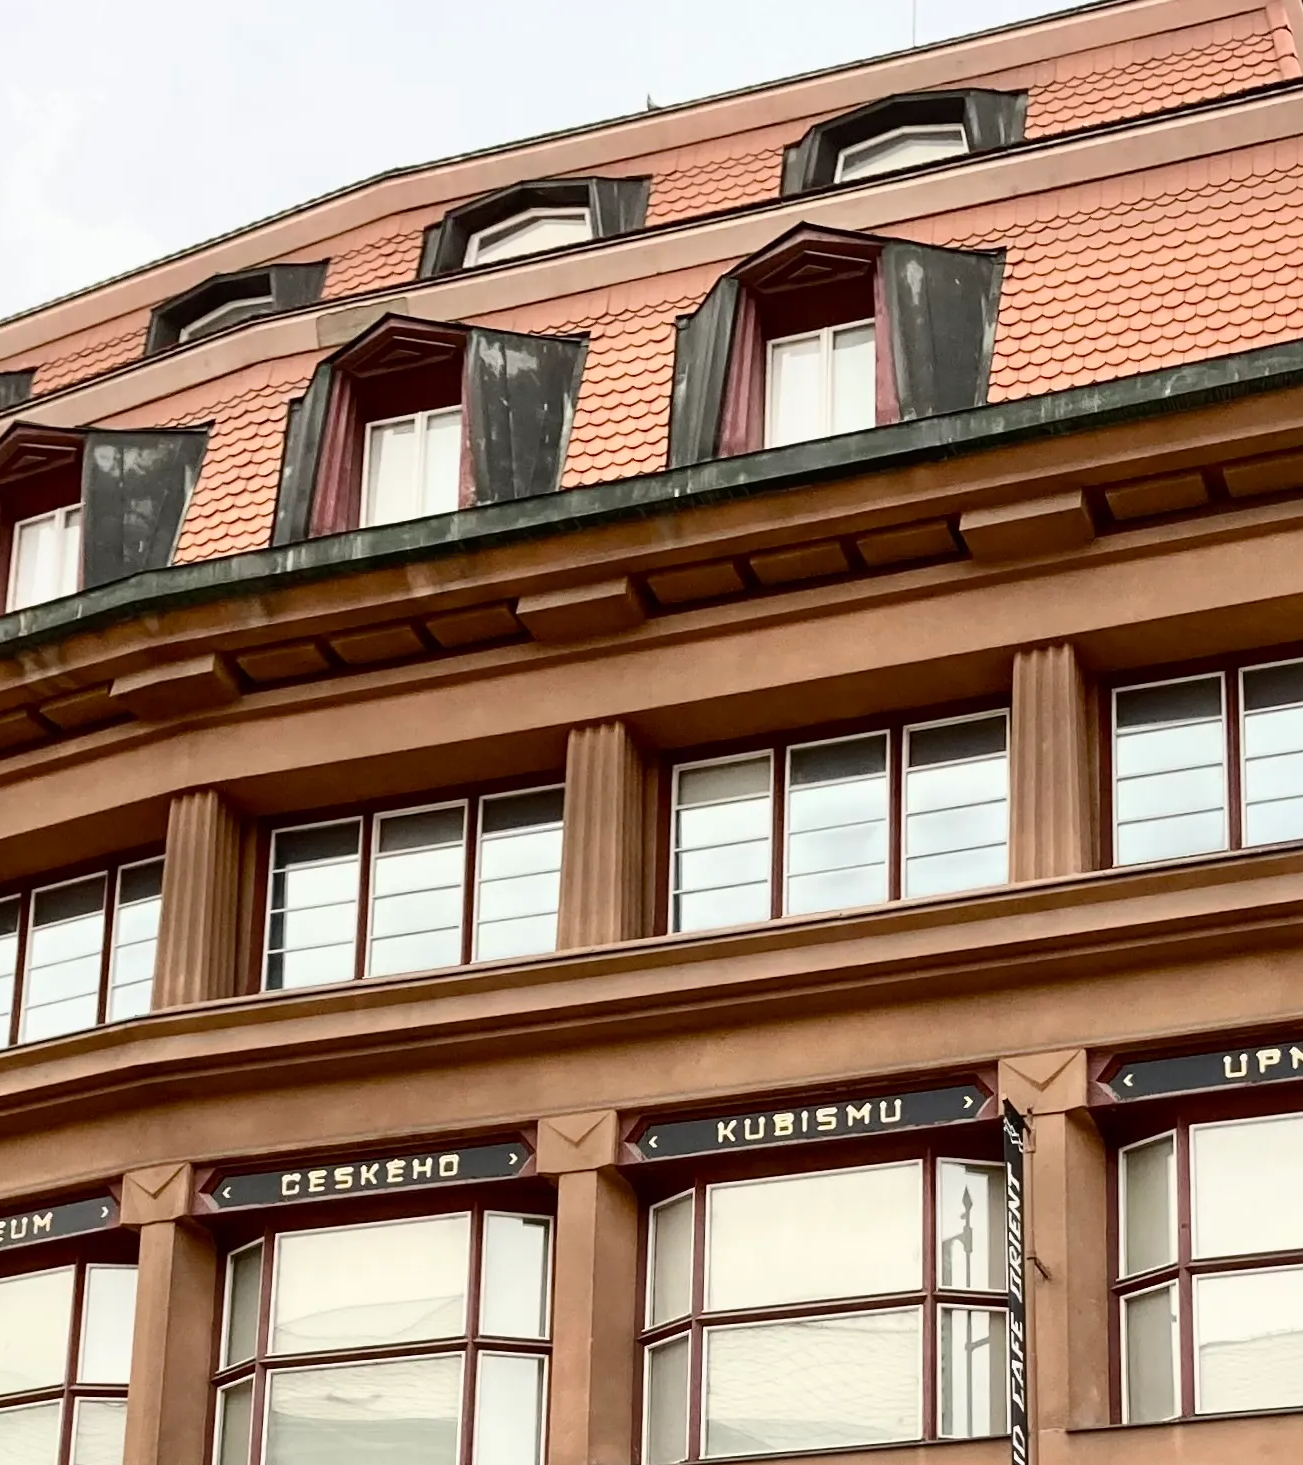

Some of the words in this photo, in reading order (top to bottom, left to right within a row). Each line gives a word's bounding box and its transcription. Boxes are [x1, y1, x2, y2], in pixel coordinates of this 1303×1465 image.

[717, 1099, 903, 1143] KUBISMU
[1007, 1161, 1023, 1303] ORIENT
[1010, 1312, 1025, 1413] CAFE
